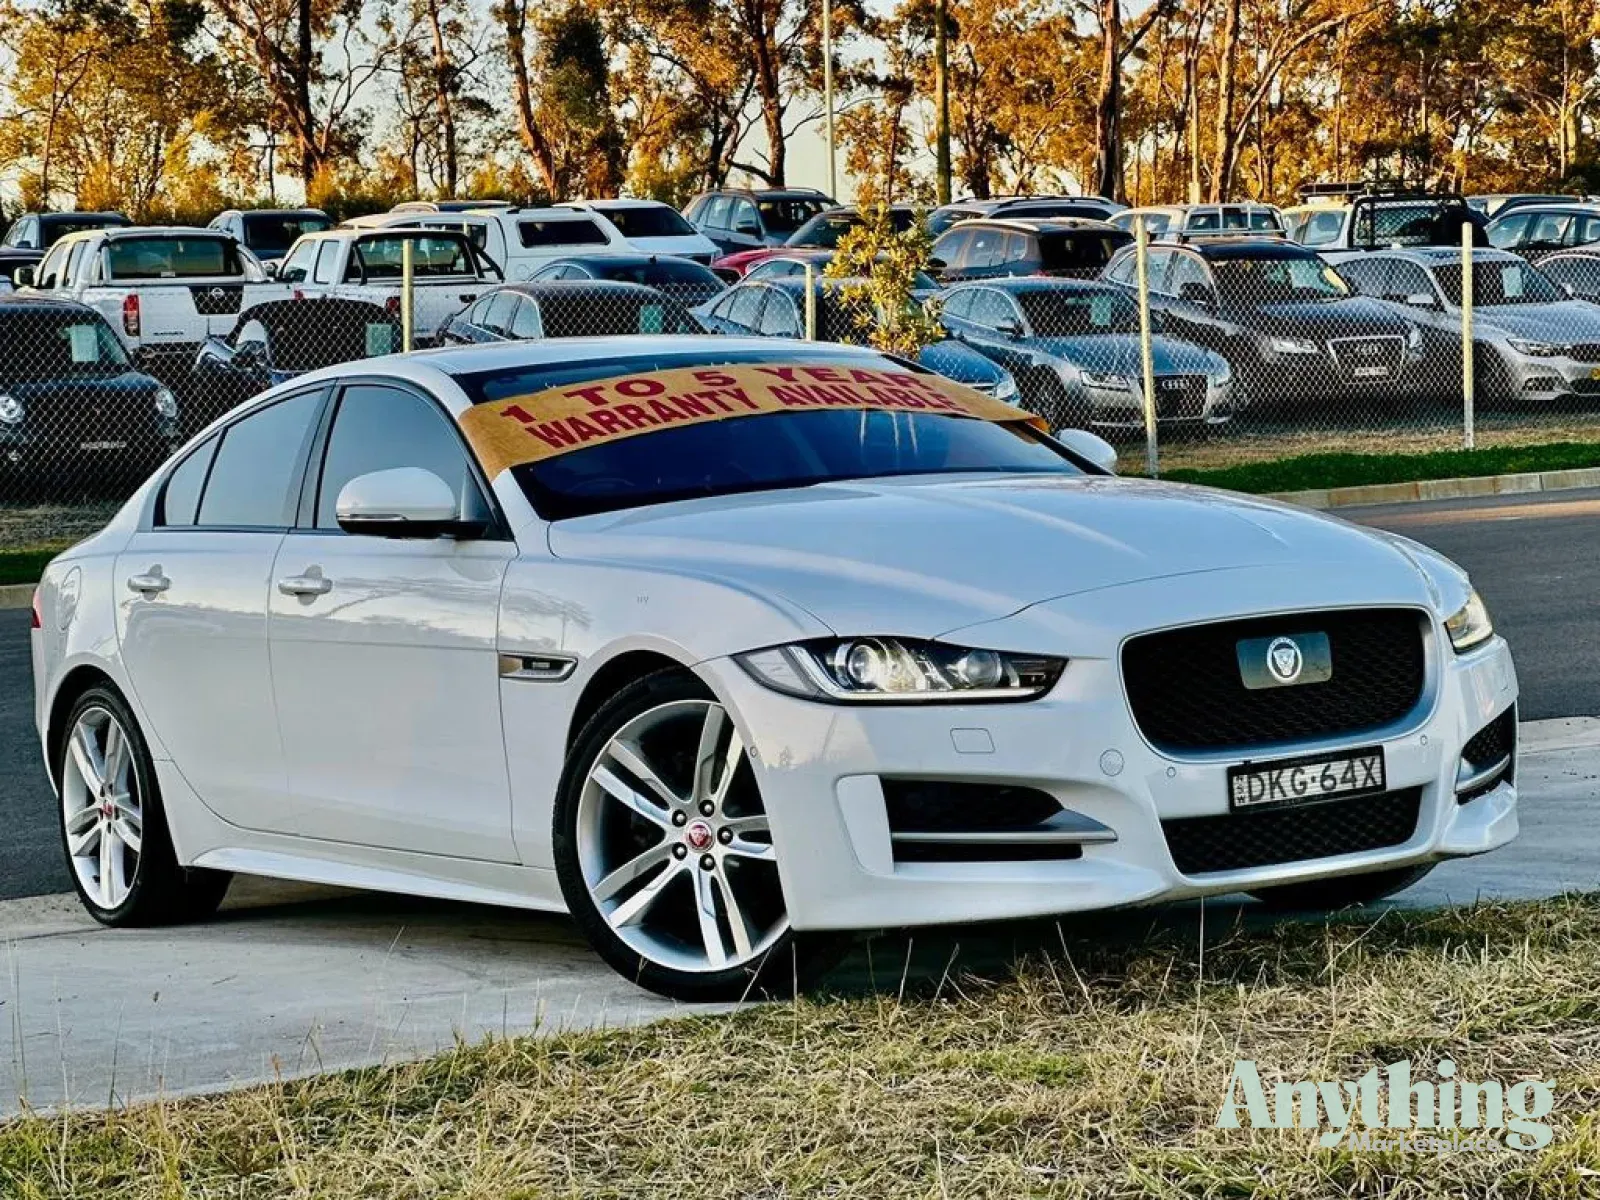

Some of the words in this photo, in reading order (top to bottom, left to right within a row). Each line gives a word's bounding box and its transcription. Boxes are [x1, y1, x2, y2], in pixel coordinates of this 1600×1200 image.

[500, 405, 536, 424] 1
[563, 379, 666, 406] TO
[692, 371, 737, 387] 5
[753, 367, 934, 391] YEAR
[525, 388, 760, 448] WARRANTY
[766, 385, 970, 413] AVAILABLE
